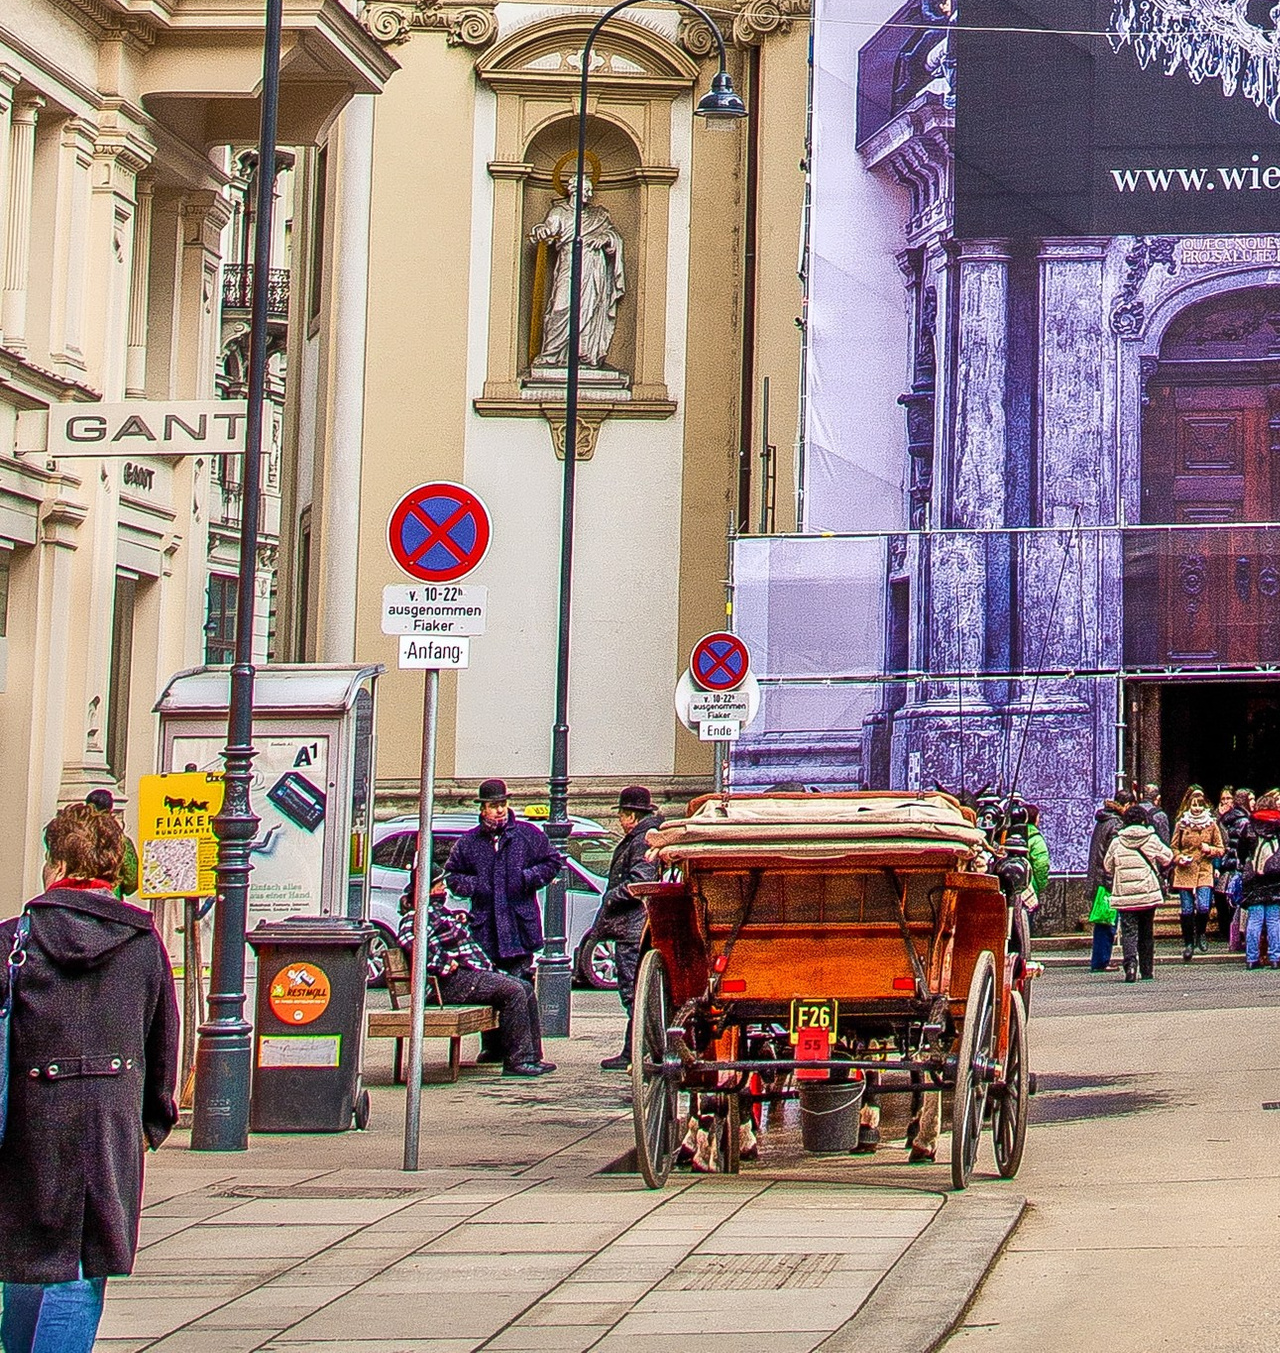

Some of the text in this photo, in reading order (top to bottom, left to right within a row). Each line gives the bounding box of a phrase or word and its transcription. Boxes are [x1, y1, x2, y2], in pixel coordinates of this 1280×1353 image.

[66, 413, 247, 442] GANT
[123, 462, 155, 491] GANT
[409, 590, 419, 602] v.
[388, 605, 482, 618] ausgenommen
[413, 619, 454, 632] Fiaker
[406, 641, 461, 664] Anfang
[693, 703, 747, 712] ausgenommen
[707, 711, 731, 719] Fiaker
[707, 724, 732, 737] Ende
[798, 1006, 831, 1028] F26
[804, 1039, 821, 1051] 55
